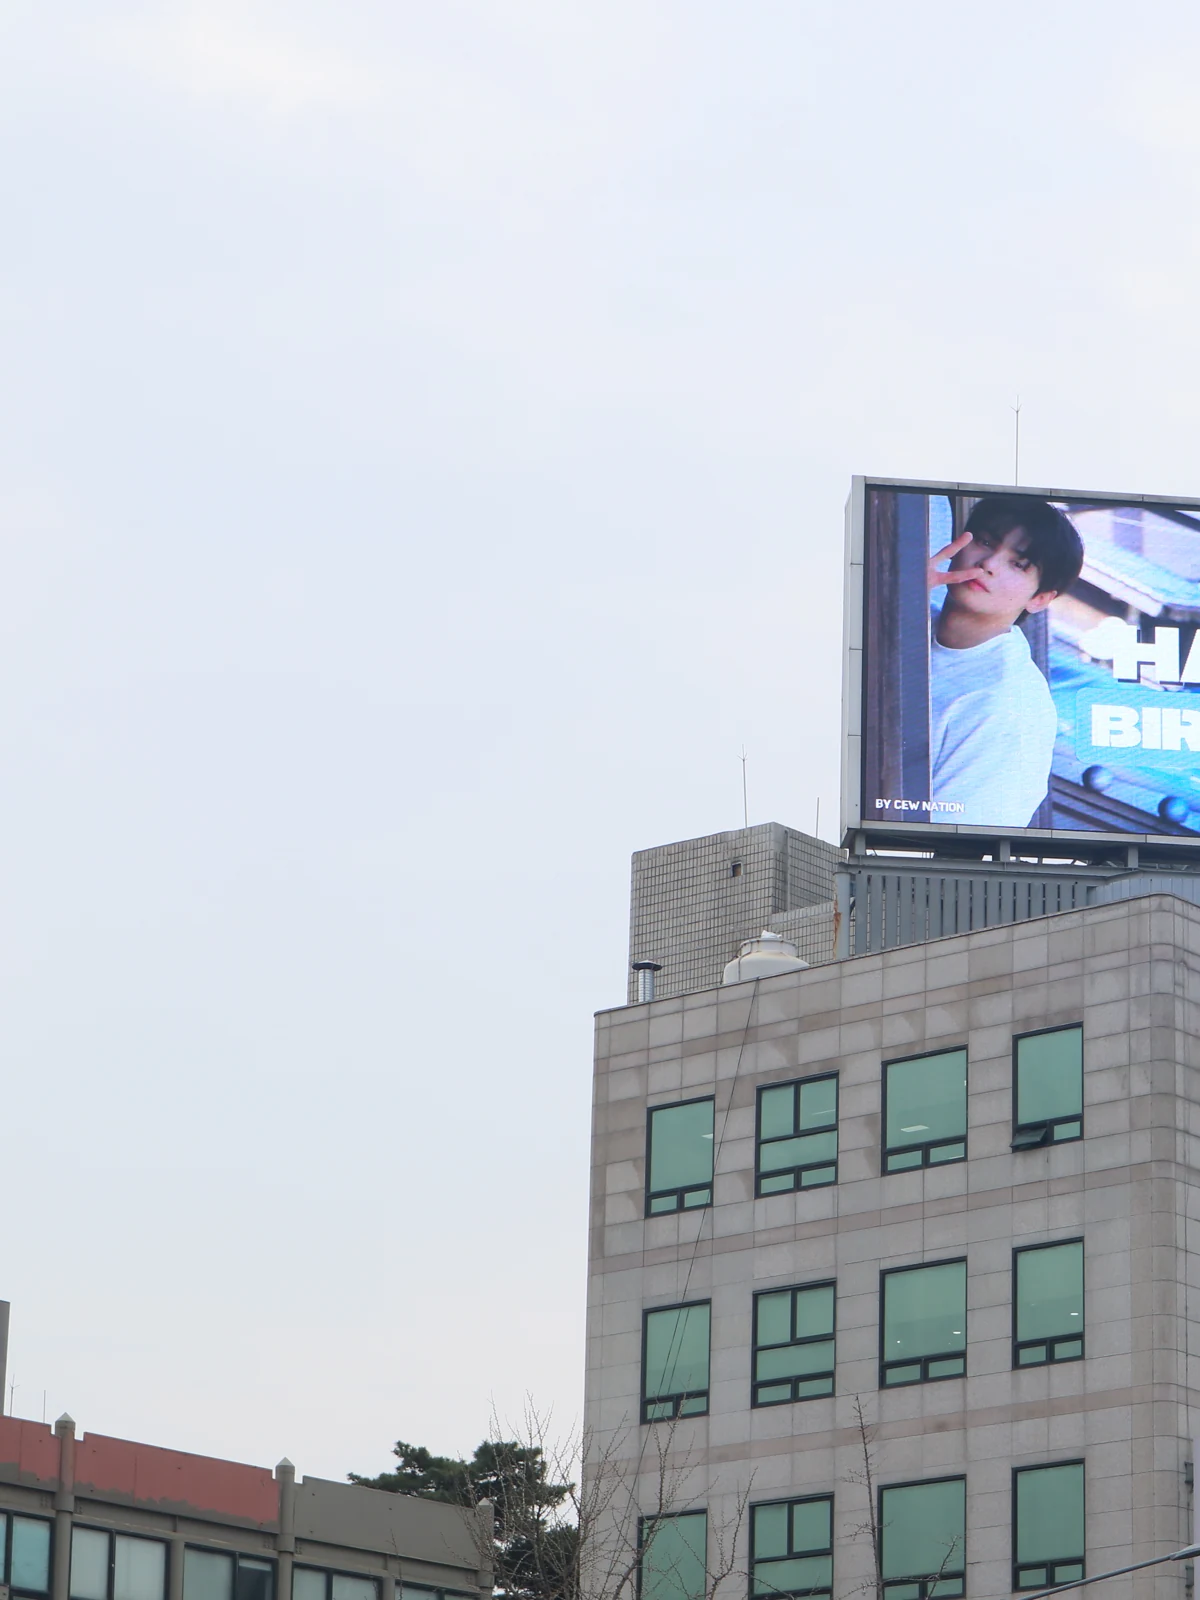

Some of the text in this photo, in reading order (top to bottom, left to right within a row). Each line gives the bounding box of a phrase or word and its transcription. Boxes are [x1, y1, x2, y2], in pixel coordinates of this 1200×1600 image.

[875, 798, 965, 813] BY CEW NATION
